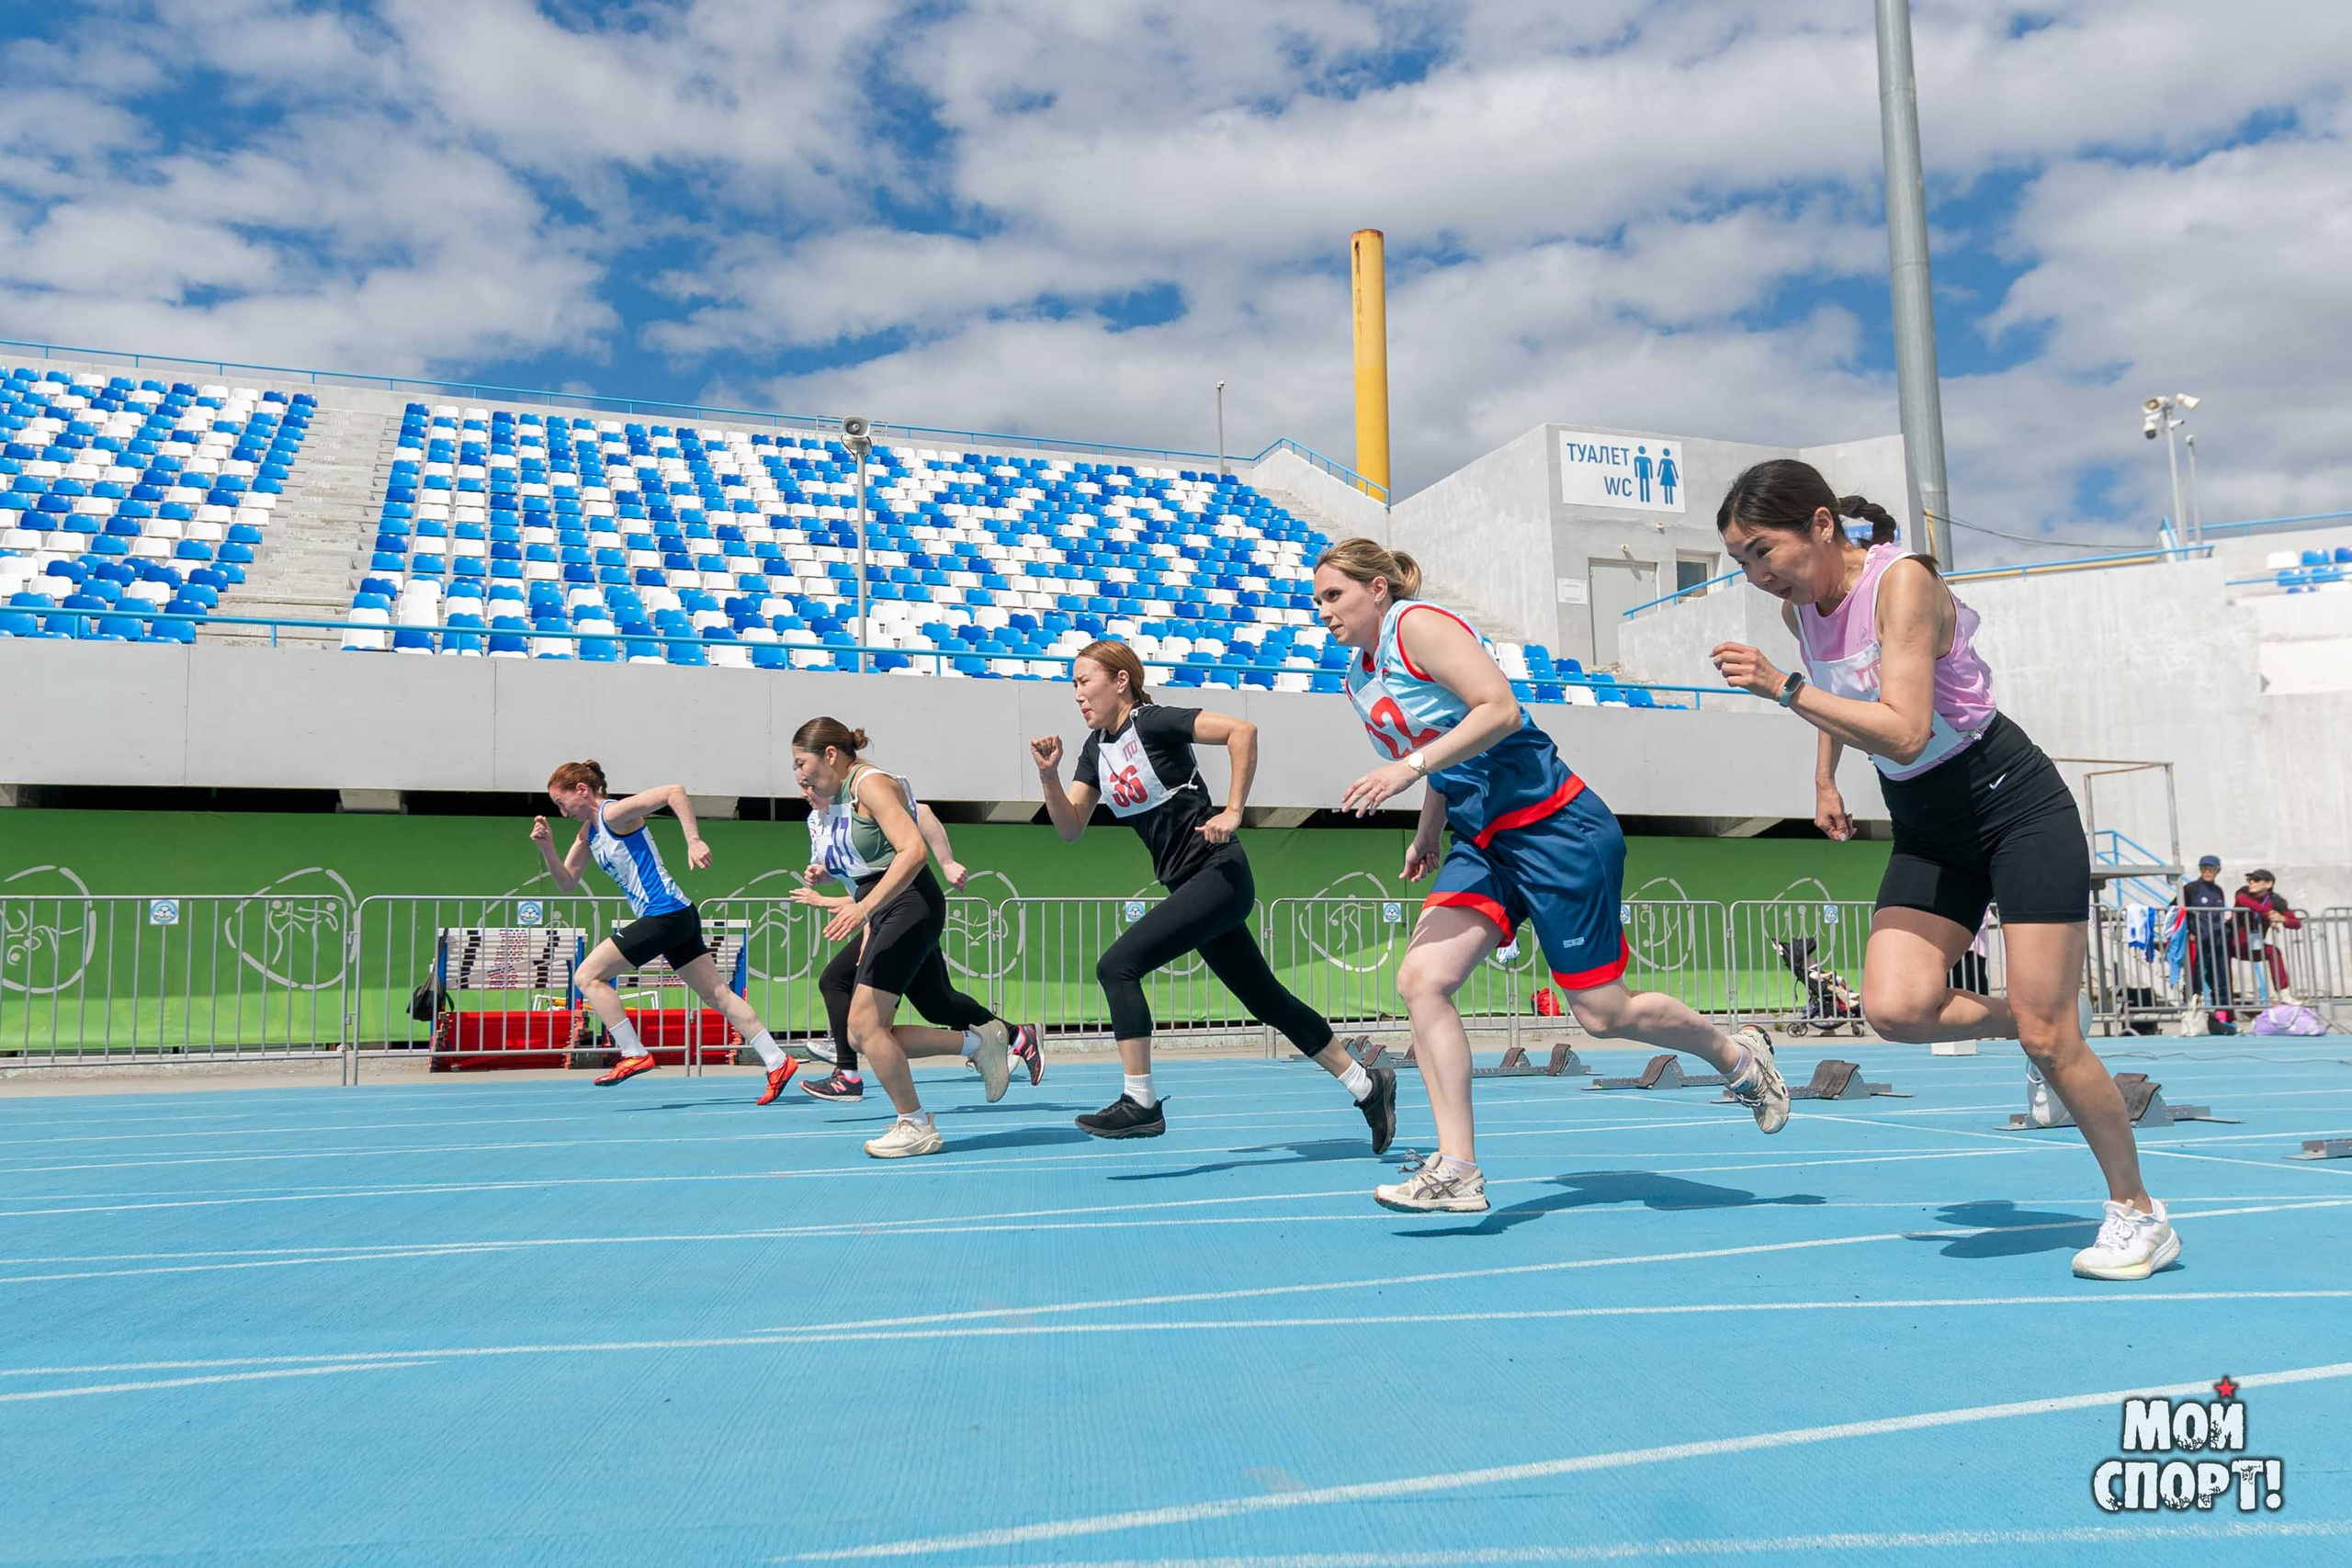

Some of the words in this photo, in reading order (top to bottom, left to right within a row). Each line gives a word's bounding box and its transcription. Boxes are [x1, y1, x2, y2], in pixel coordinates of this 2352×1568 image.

[1566, 443, 1630, 467] ТУАЛЕТ
[1603, 476, 1633, 497] WC
[1110, 764, 1148, 808] 36
